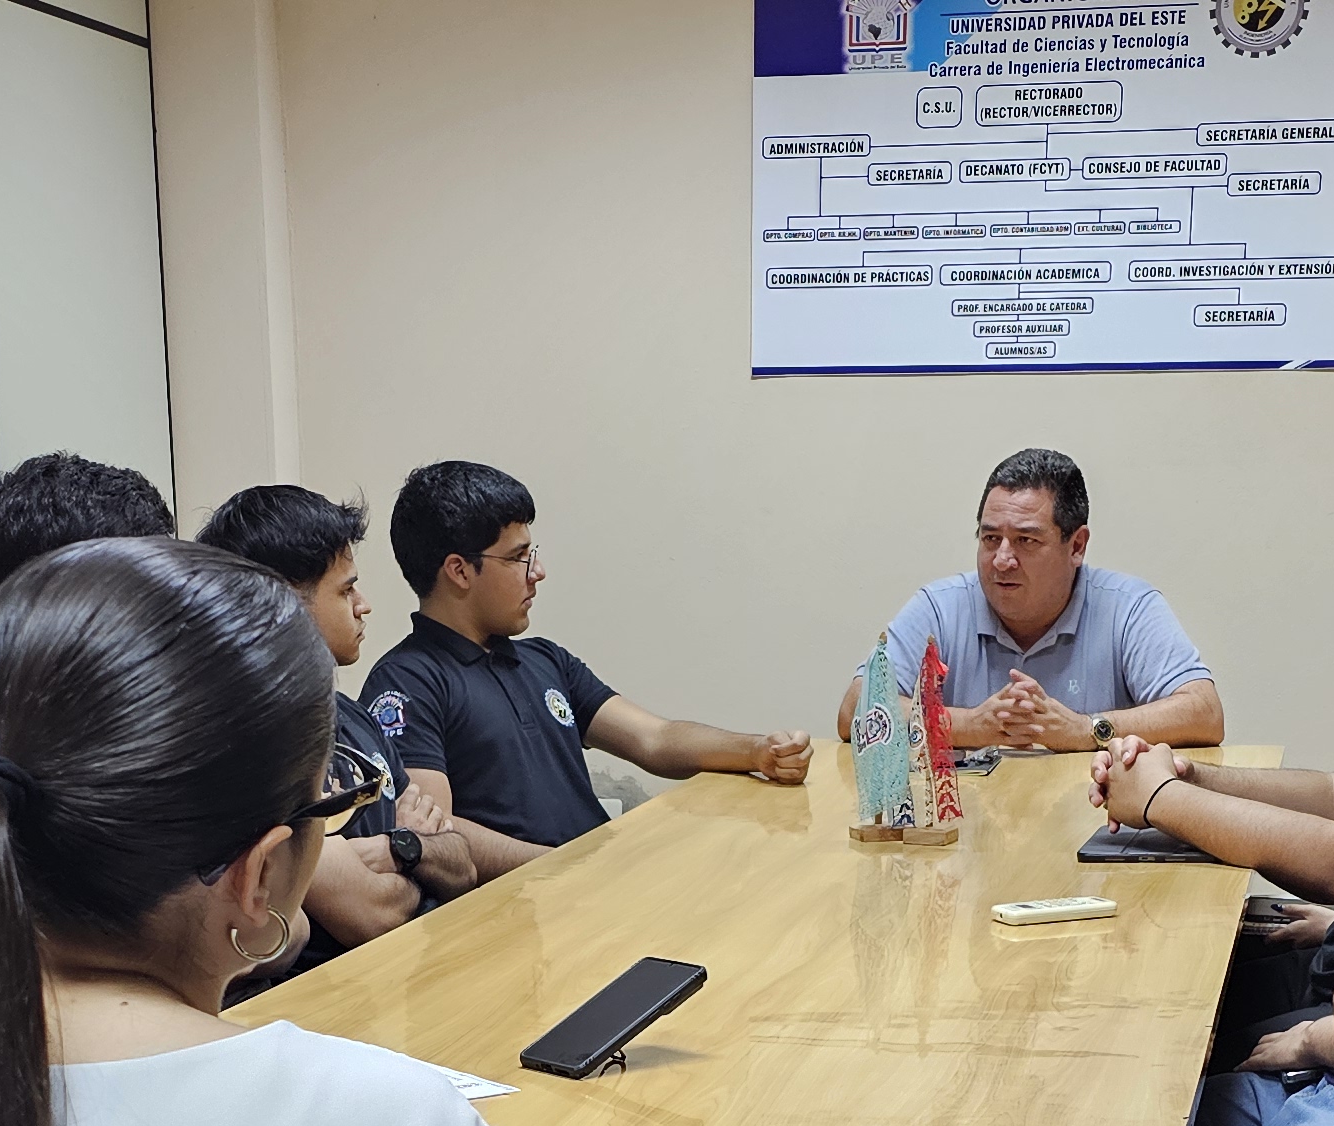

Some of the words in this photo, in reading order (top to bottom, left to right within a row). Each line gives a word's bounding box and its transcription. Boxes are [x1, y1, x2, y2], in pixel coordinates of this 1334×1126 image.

[950, 16, 1046, 33] UNIVERSIDAD
[1052, 13, 1114, 30] PRIVADA
[1120, 11, 1146, 27] DEL
[1151, 10, 1187, 26] ESTE
[946, 40, 1006, 55] Facultad
[1012, 38, 1028, 53] de
[1034, 36, 1095, 52] Ciencias
[1099, 38, 1108, 52] y
[1112, 32, 1189, 50] Tecnología
[852, 53, 903, 65] UPE
[929, 63, 981, 77] Carrera
[986, 61, 1003, 75] de
[1008, 56, 1080, 77] Ingeniería
[1085, 54, 1205, 72] Electromecánica
[1014, 87, 1083, 101] RECTORADO
[922, 101, 956, 114] C.S.U.
[980, 103, 1118, 122] (RECTOR/VICERRECTOR)
[1205, 125, 1278, 142] SECRETARÍA
[1281, 126, 1334, 140] GENERAL
[769, 139, 864, 155] ADMINISTRACIÓN
[875, 166, 944, 182] SECRETARÍA
[966, 163, 1024, 177] DECANATO
[1028, 162, 1065, 177] (FCYT)
[1088, 161, 1141, 174] CONSEJO
[1145, 161, 1160, 173] DE
[1163, 159, 1221, 172] FACULTAD
[1237, 175, 1310, 192] SECRETARÍA
[1136, 223, 1173, 231] BIBLIOTECA
[771, 270, 850, 285] COORDINACIÓN
[853, 272, 867, 283] DE
[870, 269, 930, 284] PRÁCTICAS
[950, 267, 1032, 282] COORDINACIÓN
[1035, 267, 1100, 280] ACADEMICA
[1134, 266, 1176, 278] COORD.
[1179, 262, 1264, 278] INVESTIGACIÓN
[1269, 264, 1275, 276] Y
[957, 304, 981, 313] PROF.
[983, 303, 1034, 313] ENCARGADO
[1036, 302, 1047, 311] DE
[1049, 302, 1087, 311] CATEDRA
[1204, 307, 1275, 322] SECRETARÍA
[979, 325, 1023, 334] PROFESOR
[1025, 324, 1064, 333] AUXILIAR
[994, 346, 1047, 356] ALUMNOS/AS
